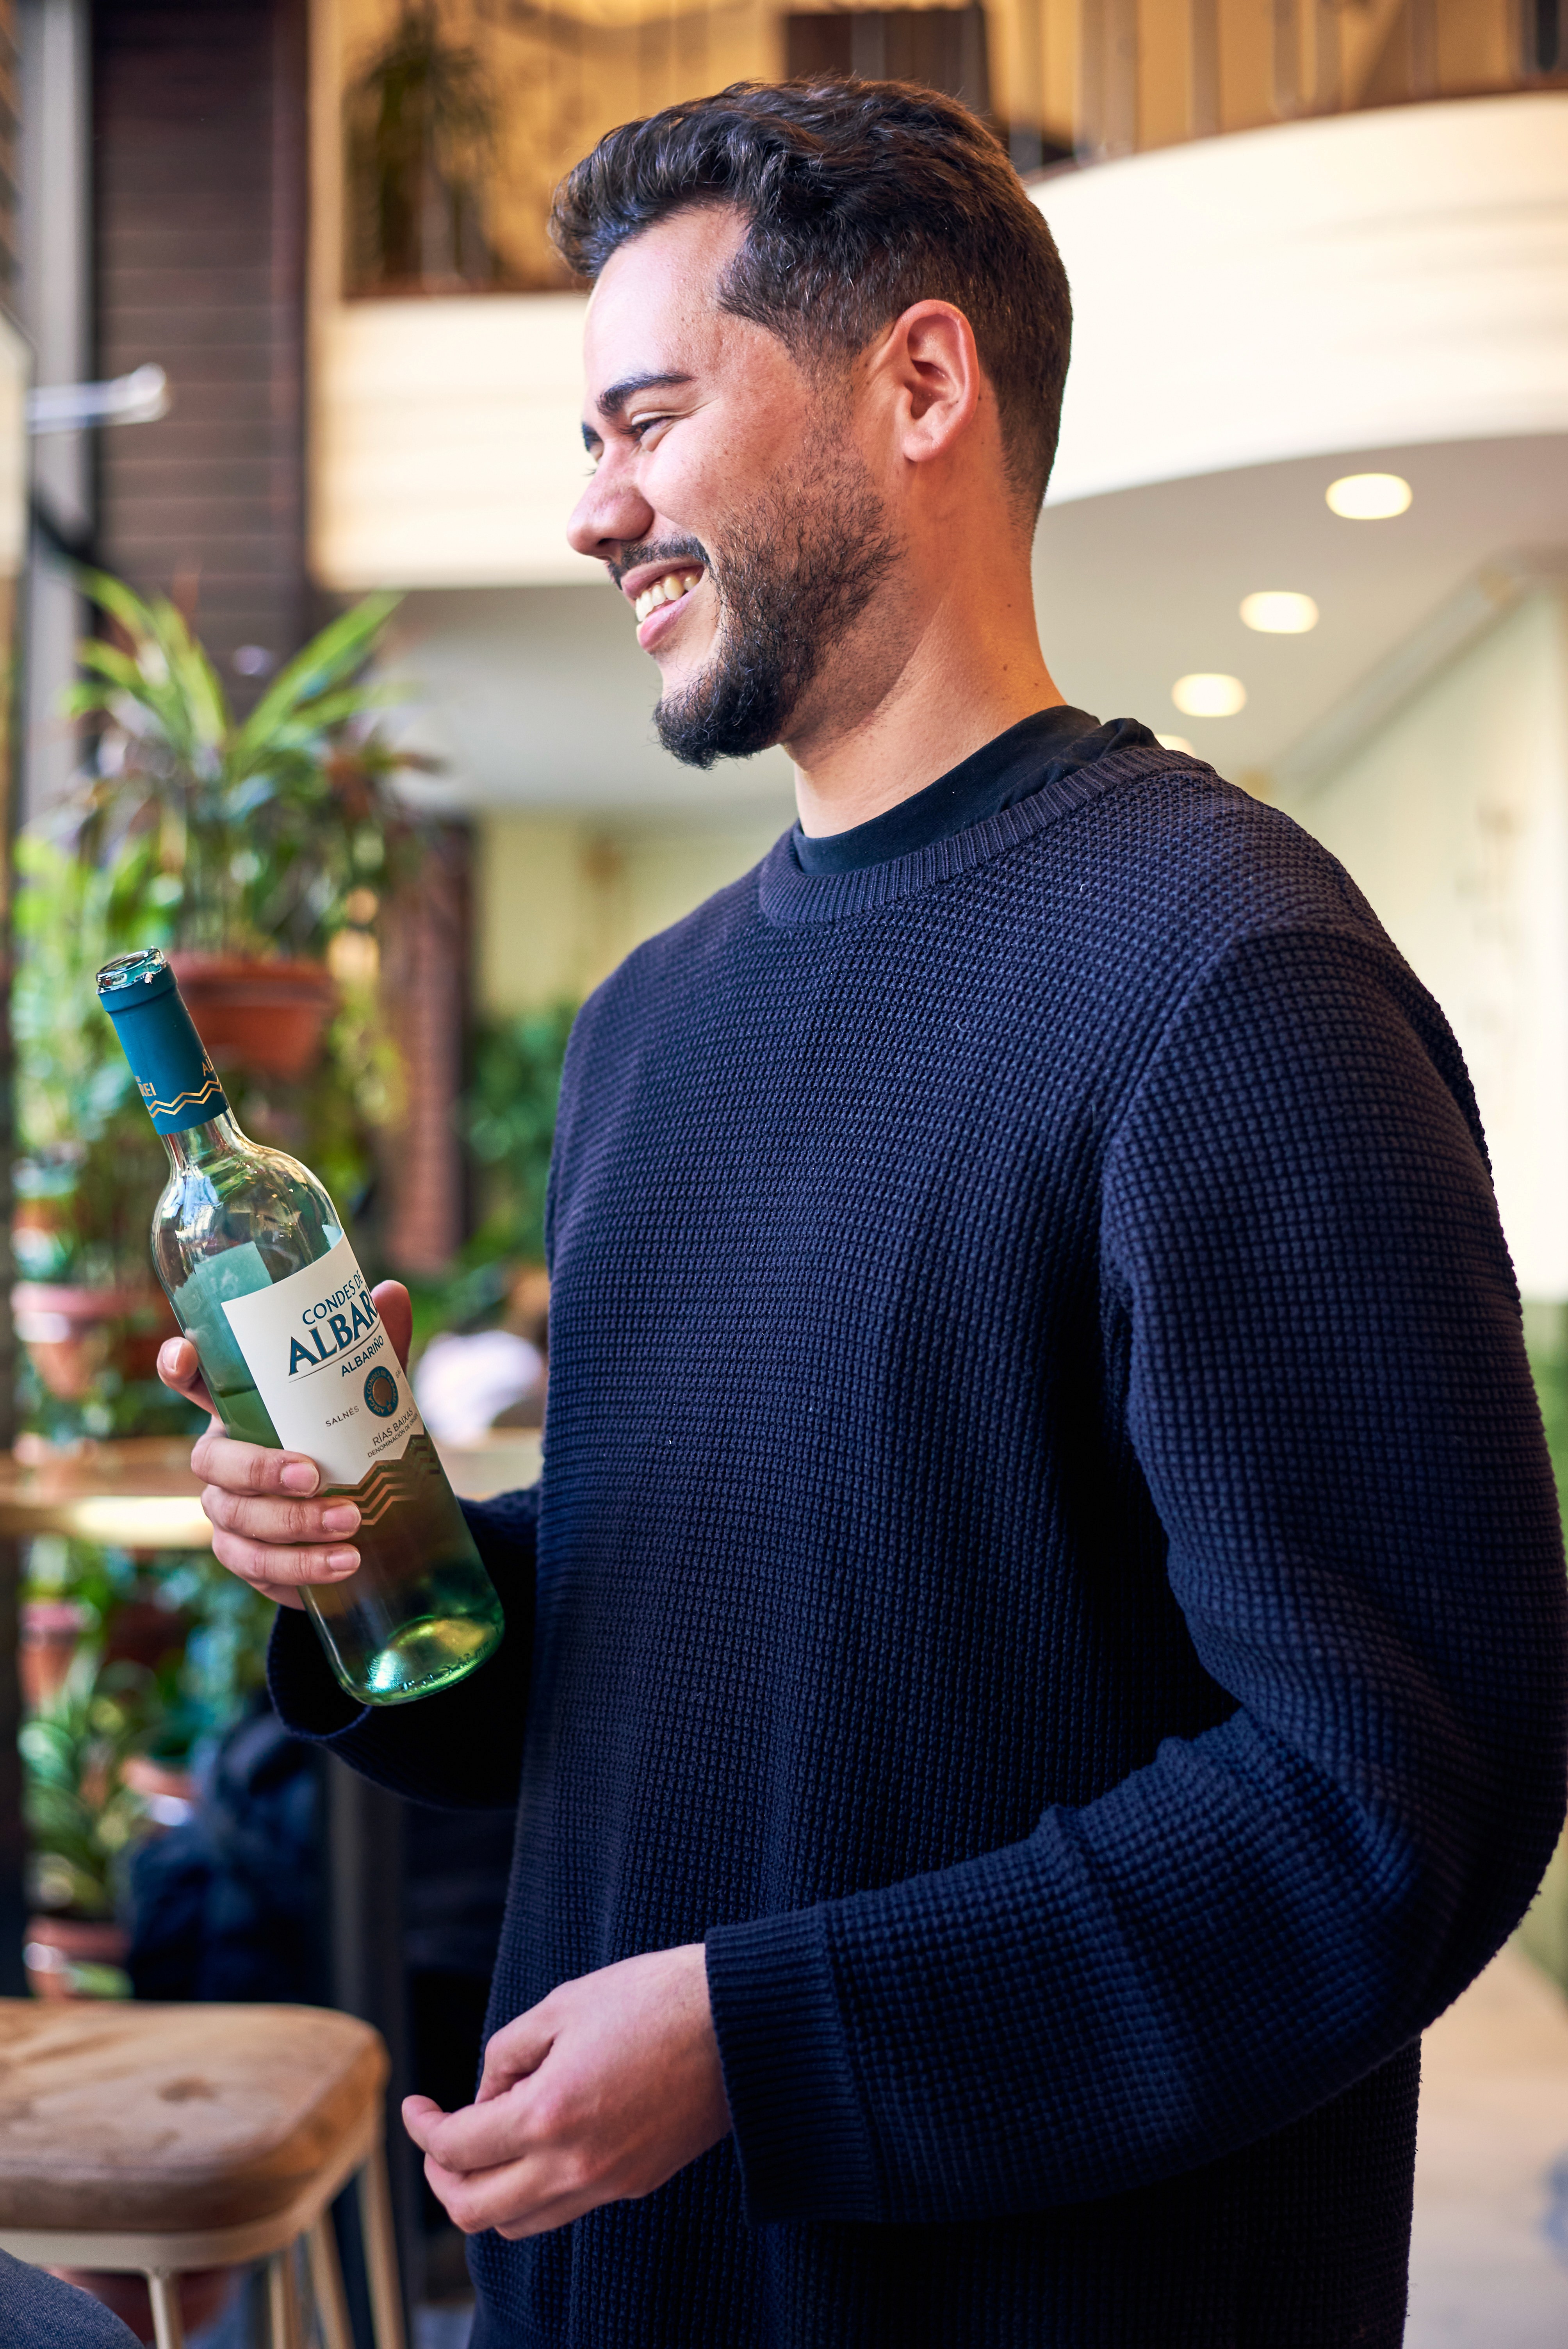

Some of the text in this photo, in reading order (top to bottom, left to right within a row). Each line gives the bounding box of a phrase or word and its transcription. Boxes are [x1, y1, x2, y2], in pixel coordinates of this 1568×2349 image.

[302, 1270, 363, 1325] CONDES DE
[341, 1335, 384, 1377] ALBARIÑO
[367, 1370, 380, 1394] CONDES
[326, 1406, 360, 1427] SALNÉS
[372, 1407, 413, 1446] RÍAS BAIXAS
[367, 1429, 406, 1458] DENOMINACIÓN
